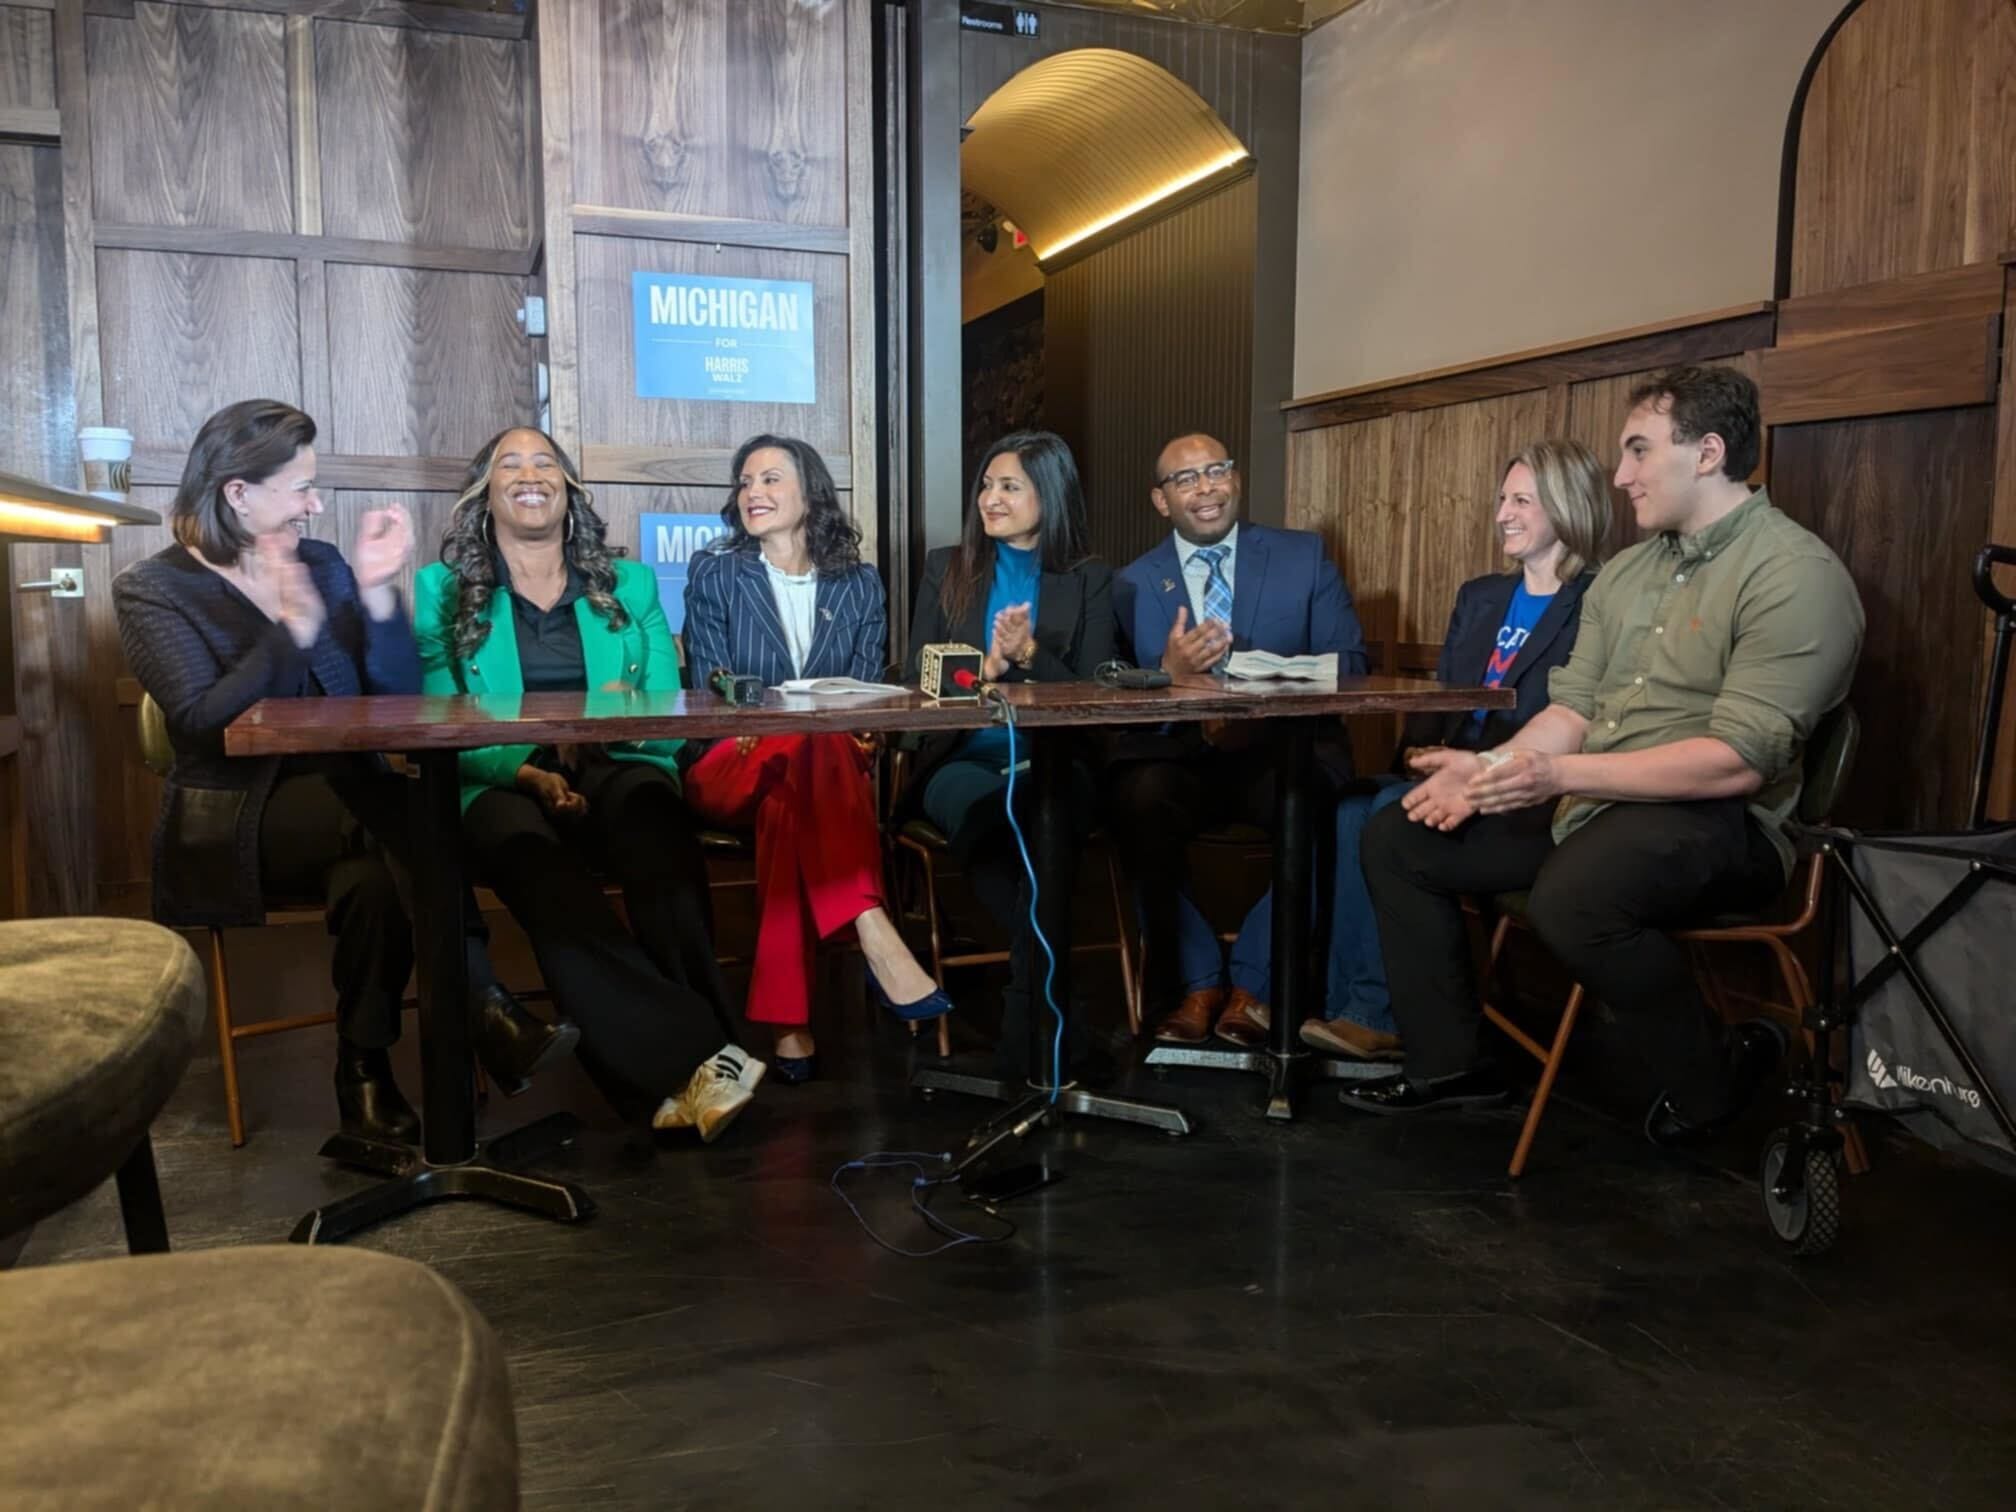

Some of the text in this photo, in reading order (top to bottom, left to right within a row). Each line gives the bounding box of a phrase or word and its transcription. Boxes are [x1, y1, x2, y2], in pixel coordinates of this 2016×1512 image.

[961, 15, 1004, 31] Restrooms
[649, 284, 799, 331] MICHIGAN
[714, 336, 738, 349] FOR
[704, 355, 750, 374] HARRIS
[711, 372, 744, 384] WALZ
